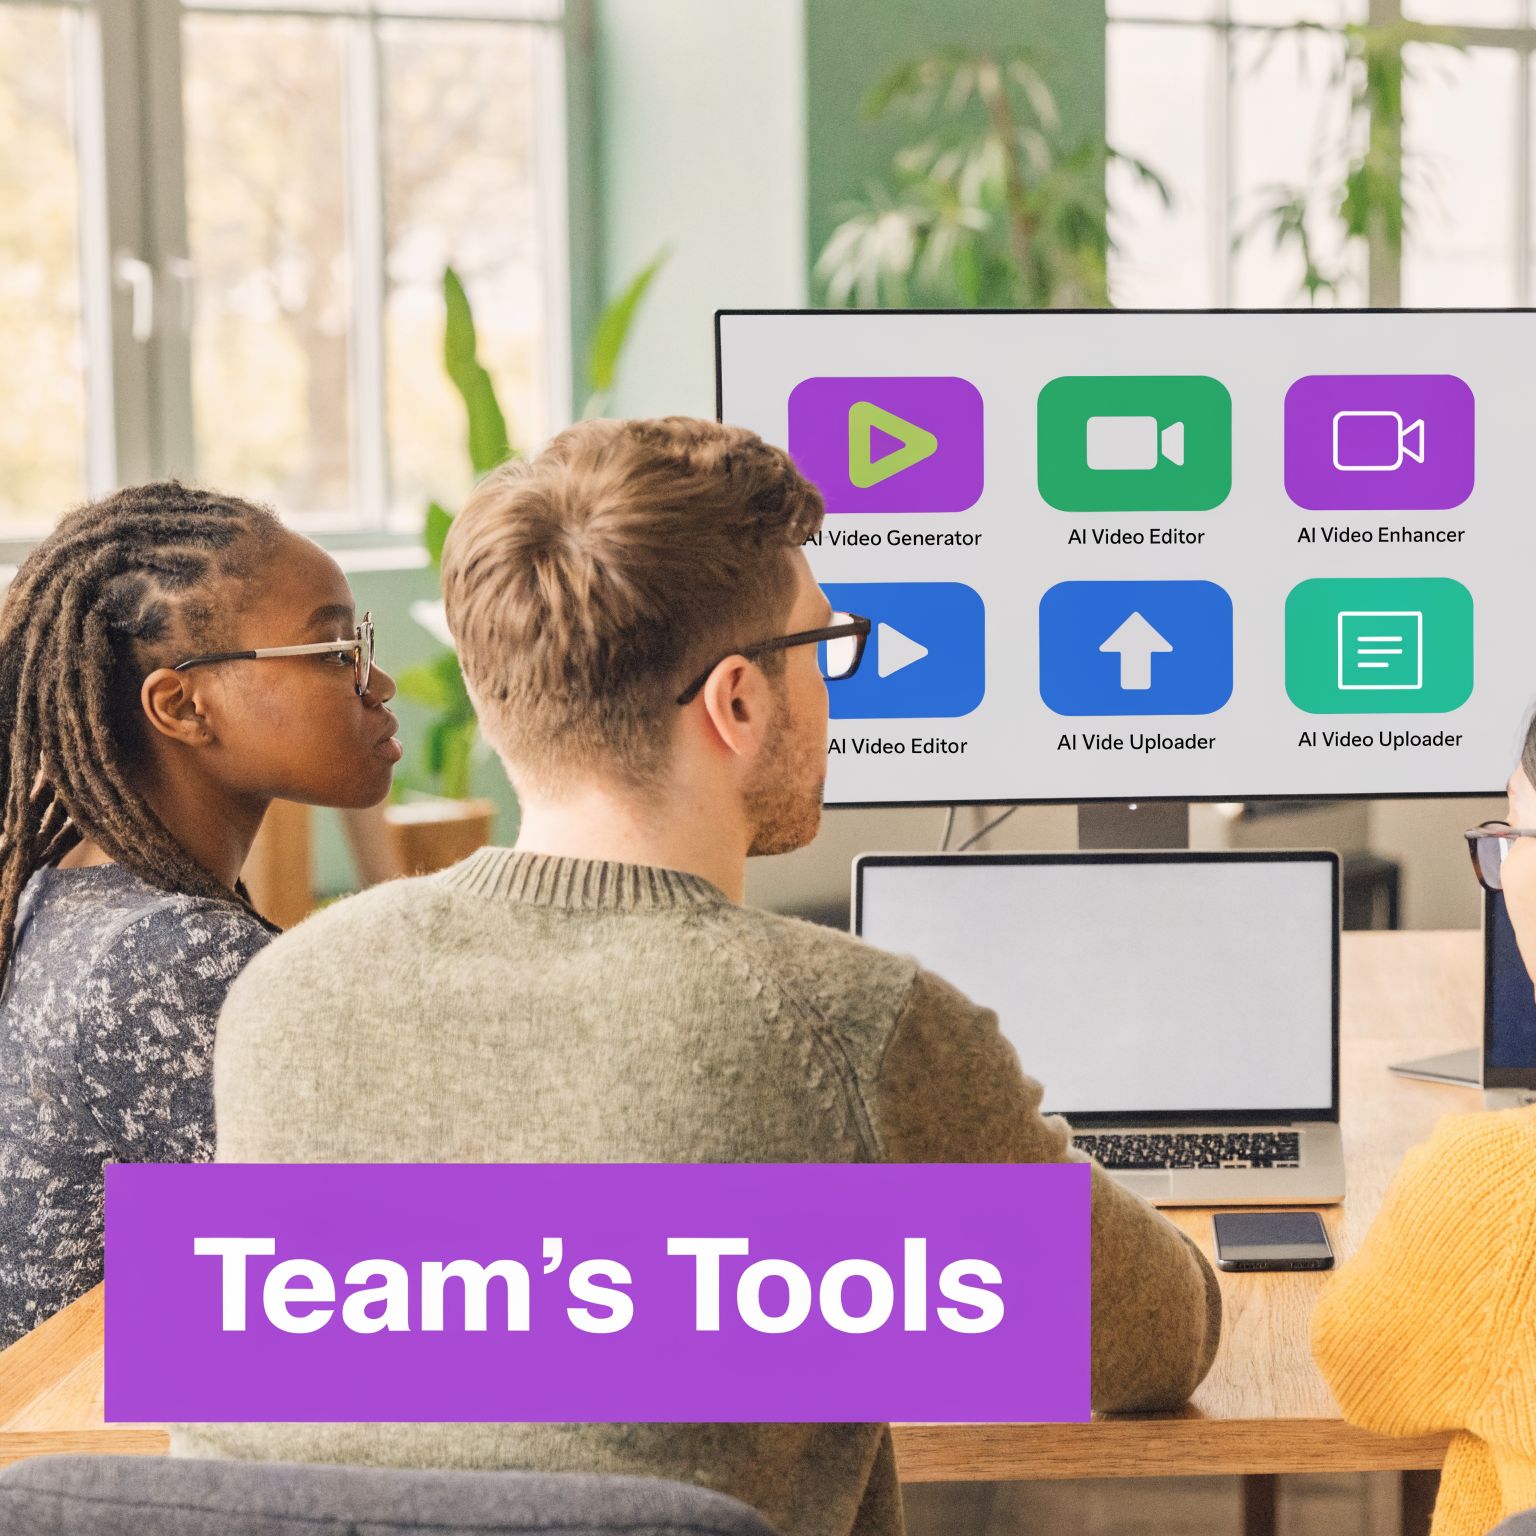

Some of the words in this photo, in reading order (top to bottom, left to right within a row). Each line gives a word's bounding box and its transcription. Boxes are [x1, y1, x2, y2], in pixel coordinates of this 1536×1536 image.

[801, 530, 822, 546] AI
[827, 529, 882, 547] Video
[886, 529, 983, 547] Generator
[1067, 528, 1087, 545] AI
[1091, 528, 1145, 545] Video
[1149, 527, 1206, 545] Editor
[1297, 527, 1316, 544] AI
[1320, 526, 1374, 543] Video
[1378, 526, 1466, 543] Enhancer
[827, 738, 846, 755] AI
[850, 737, 906, 755] Video
[911, 737, 968, 755] Editor
[1056, 734, 1077, 751] AI
[1081, 733, 1124, 751] Vide
[1129, 733, 1217, 755] Uploader
[1297, 731, 1317, 747] AI
[1321, 730, 1374, 748] Video
[1379, 730, 1463, 751] Uploader
